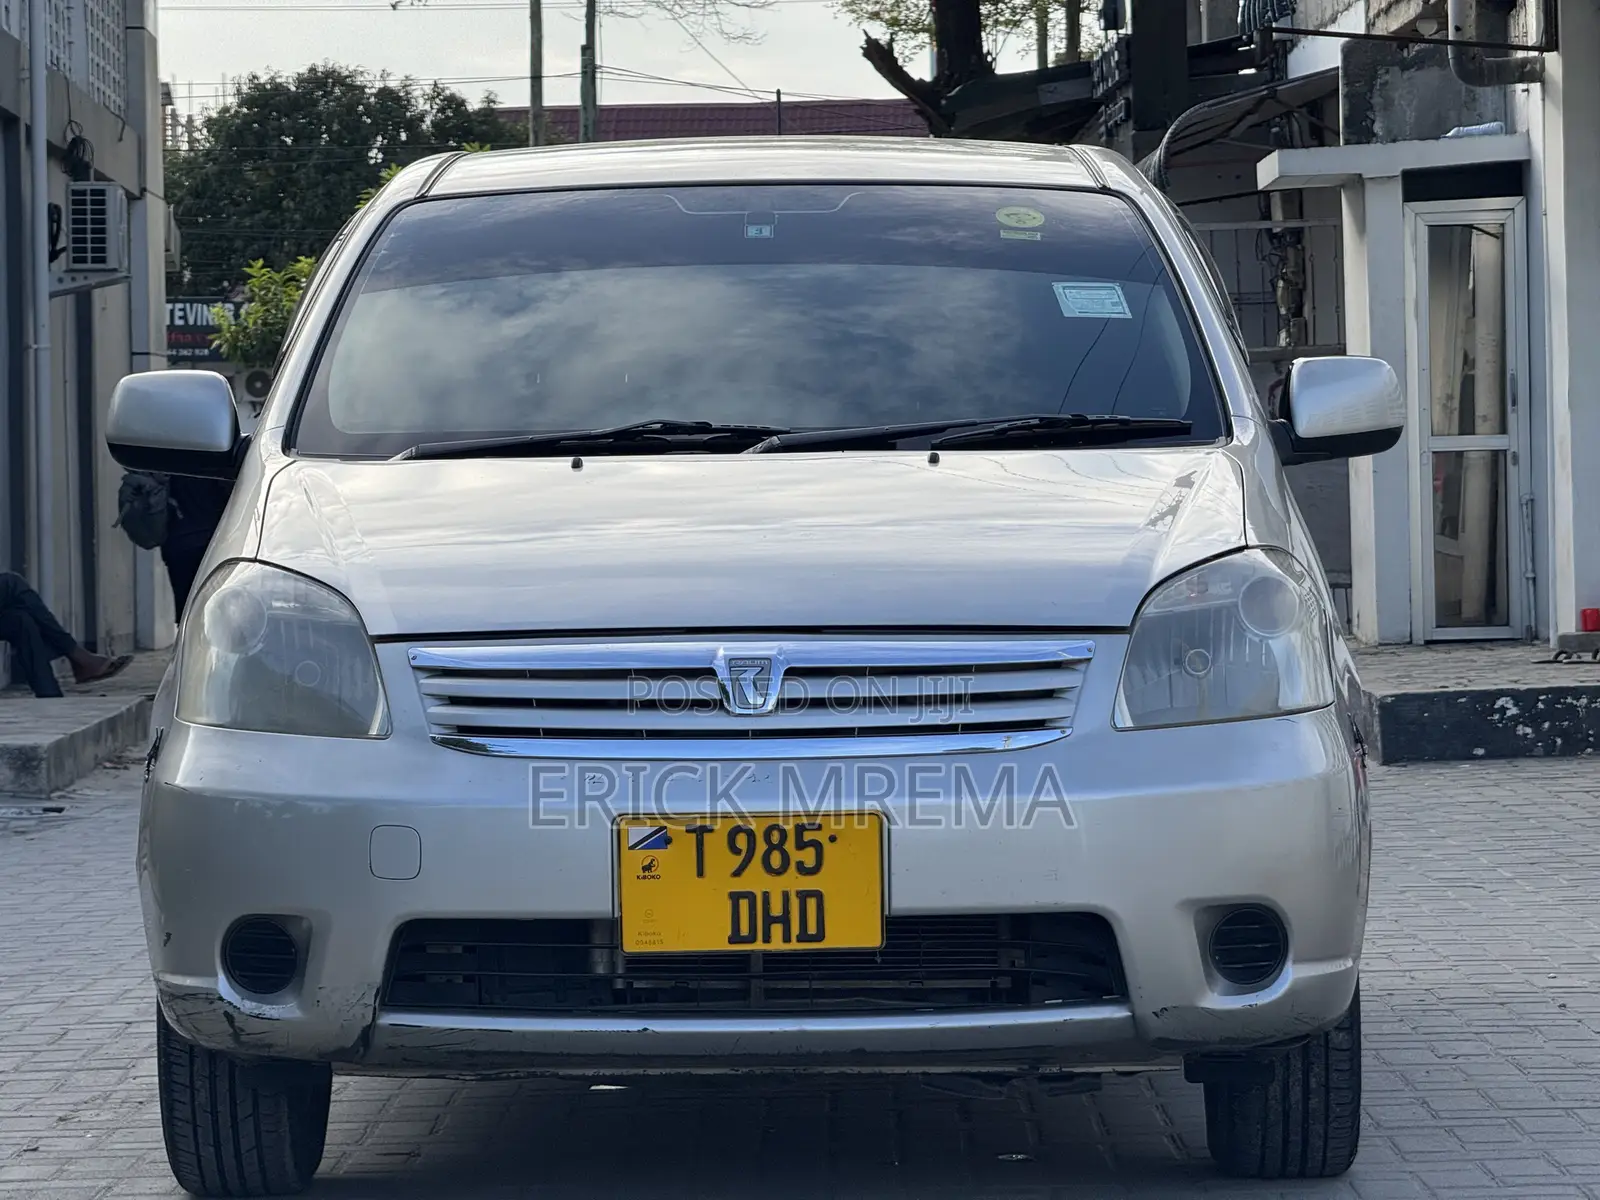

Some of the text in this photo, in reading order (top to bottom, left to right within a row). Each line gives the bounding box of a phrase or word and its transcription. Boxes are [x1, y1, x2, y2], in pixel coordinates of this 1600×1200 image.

[685, 823, 823, 878] T 985
[727, 889, 826, 944] DHD
